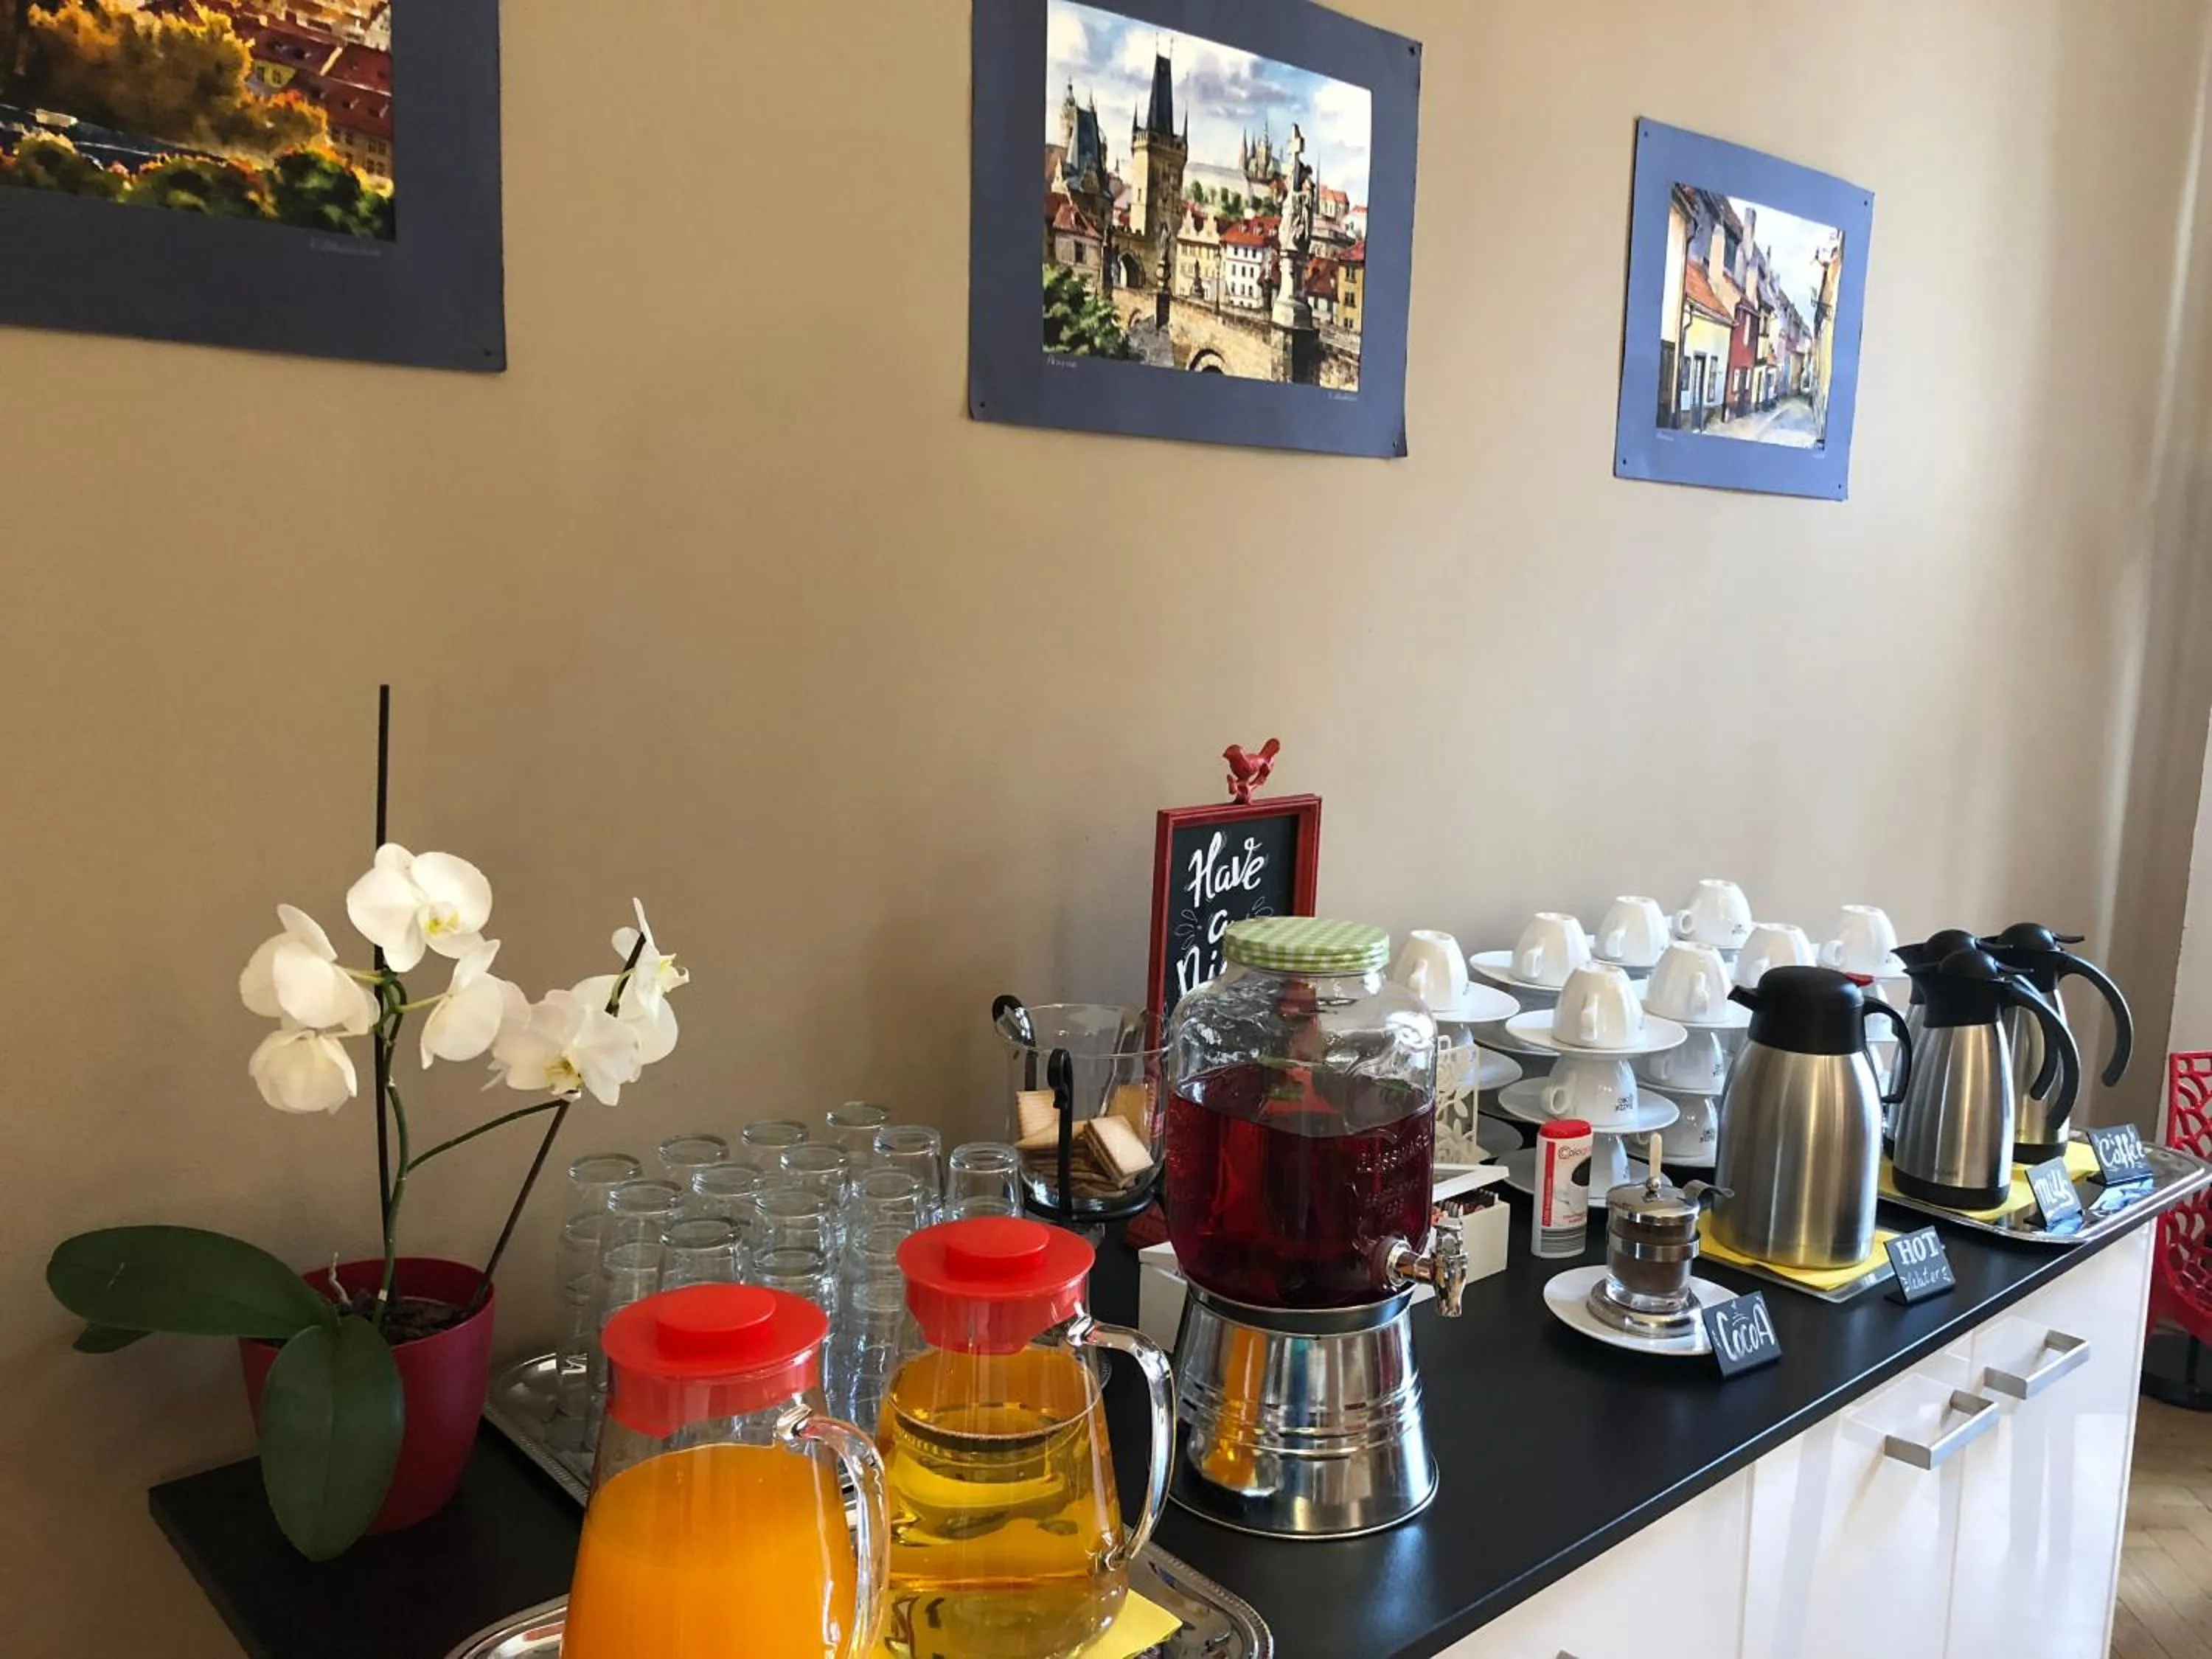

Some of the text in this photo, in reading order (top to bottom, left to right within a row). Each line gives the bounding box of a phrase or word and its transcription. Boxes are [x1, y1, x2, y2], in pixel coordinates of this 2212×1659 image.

[1187, 830, 1265, 908] Have
[2099, 1133, 2145, 1168] Coffee
[1895, 1231, 1940, 1265] HOT
